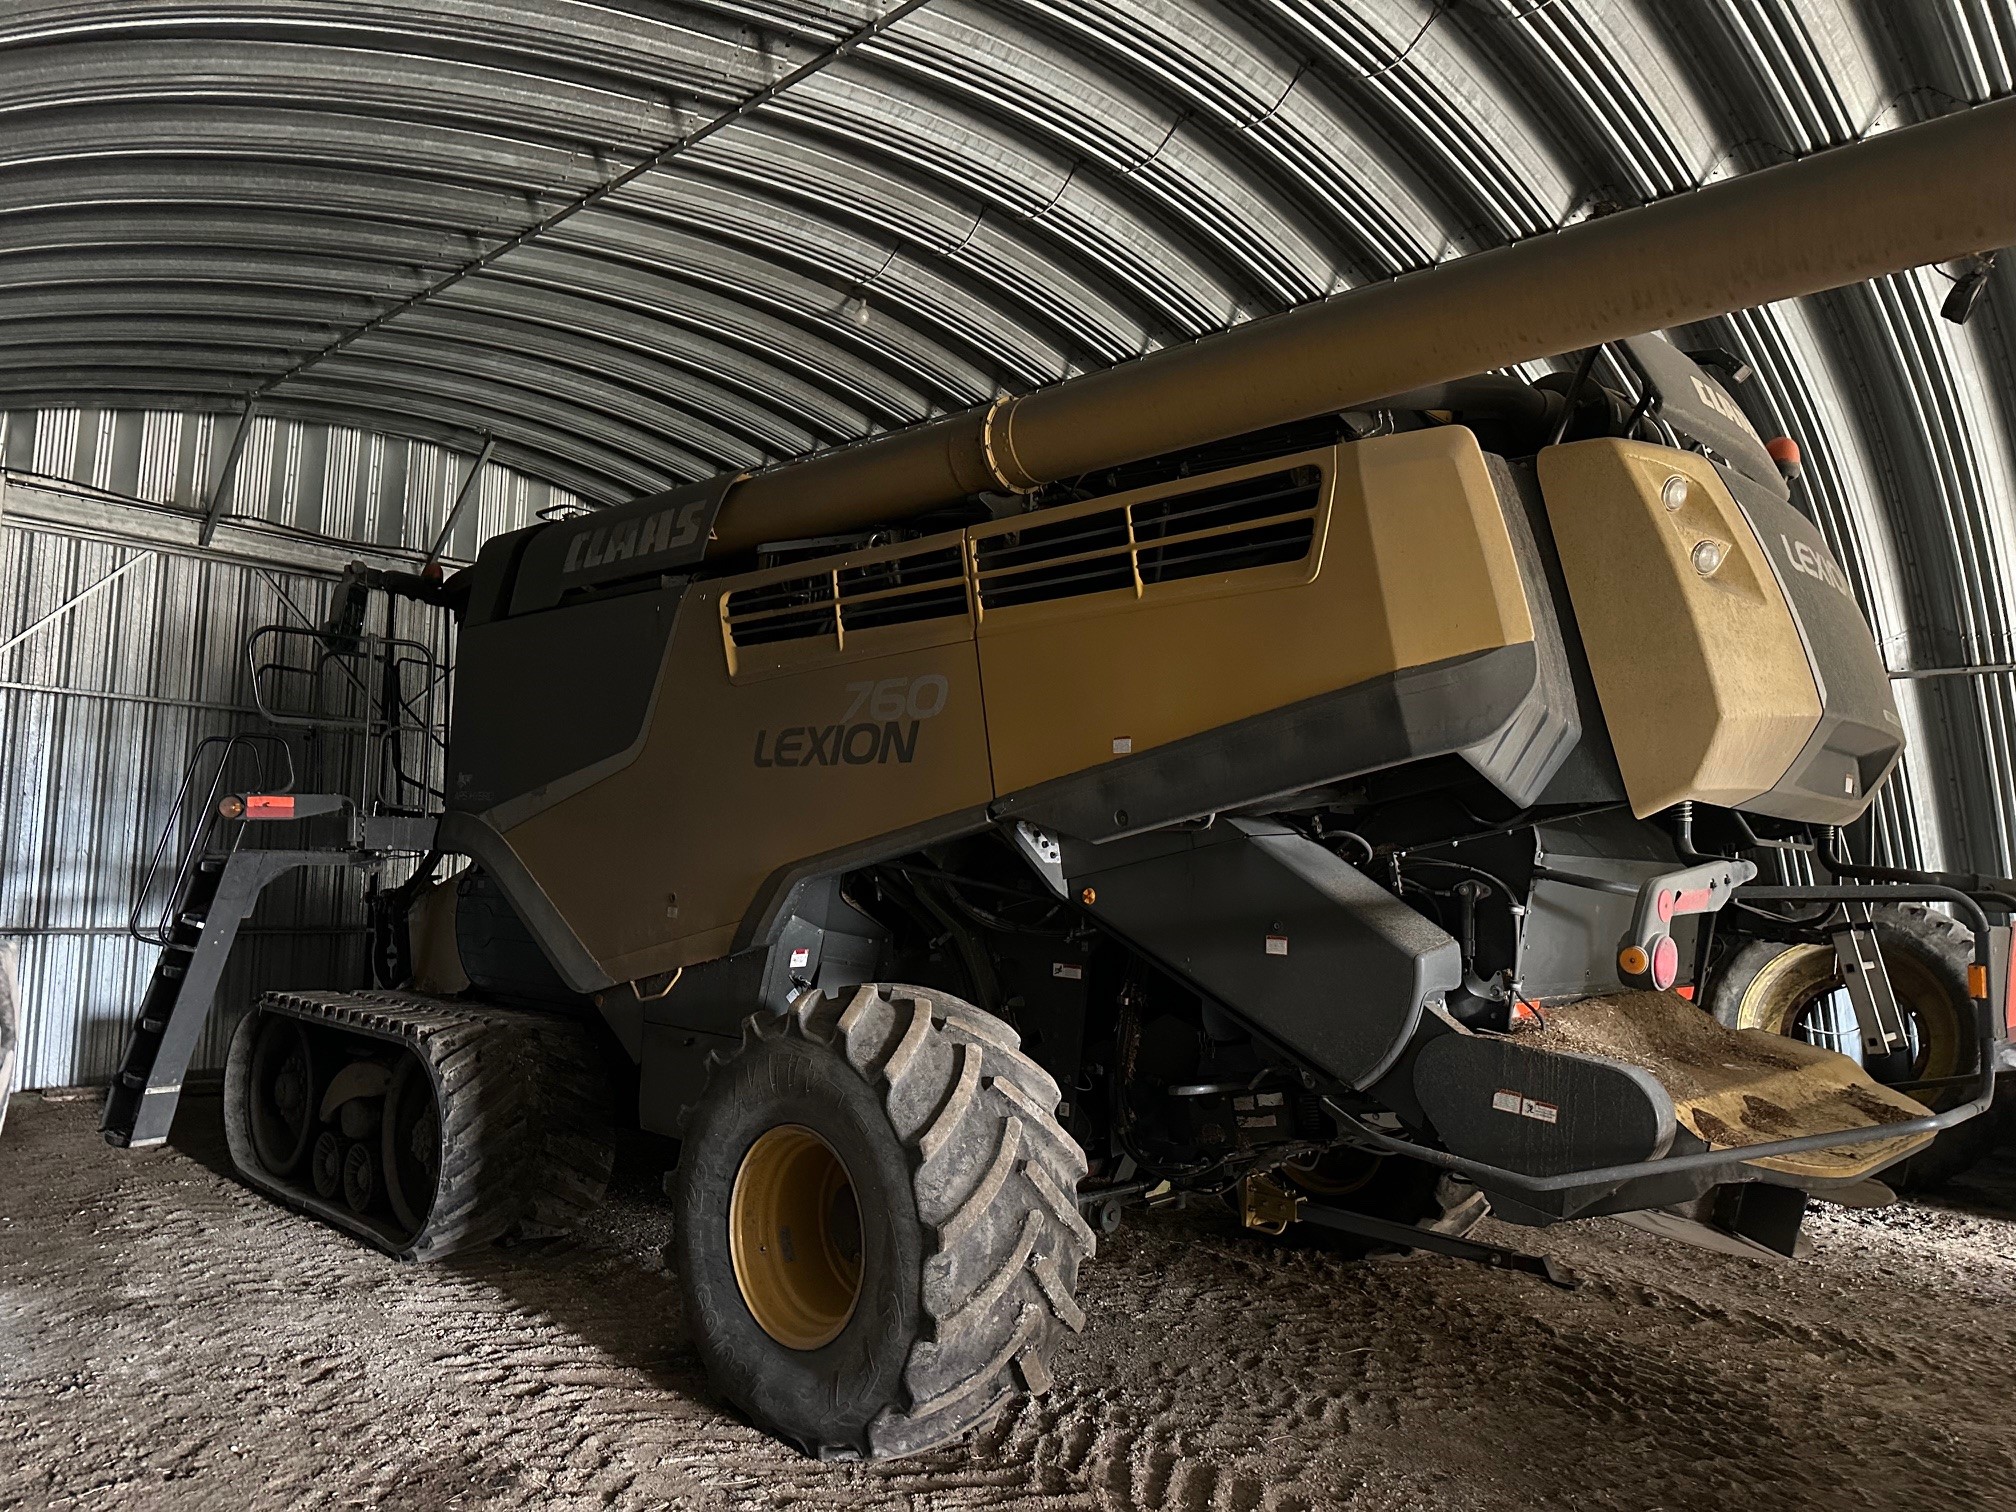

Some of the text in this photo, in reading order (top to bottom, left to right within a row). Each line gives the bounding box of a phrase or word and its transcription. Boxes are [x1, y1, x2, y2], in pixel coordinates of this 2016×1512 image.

[562, 499, 707, 573] CLAAS
[1780, 533, 1849, 597] LEXIO
[840, 674, 949, 724] 760
[753, 719, 920, 768] LEXION
